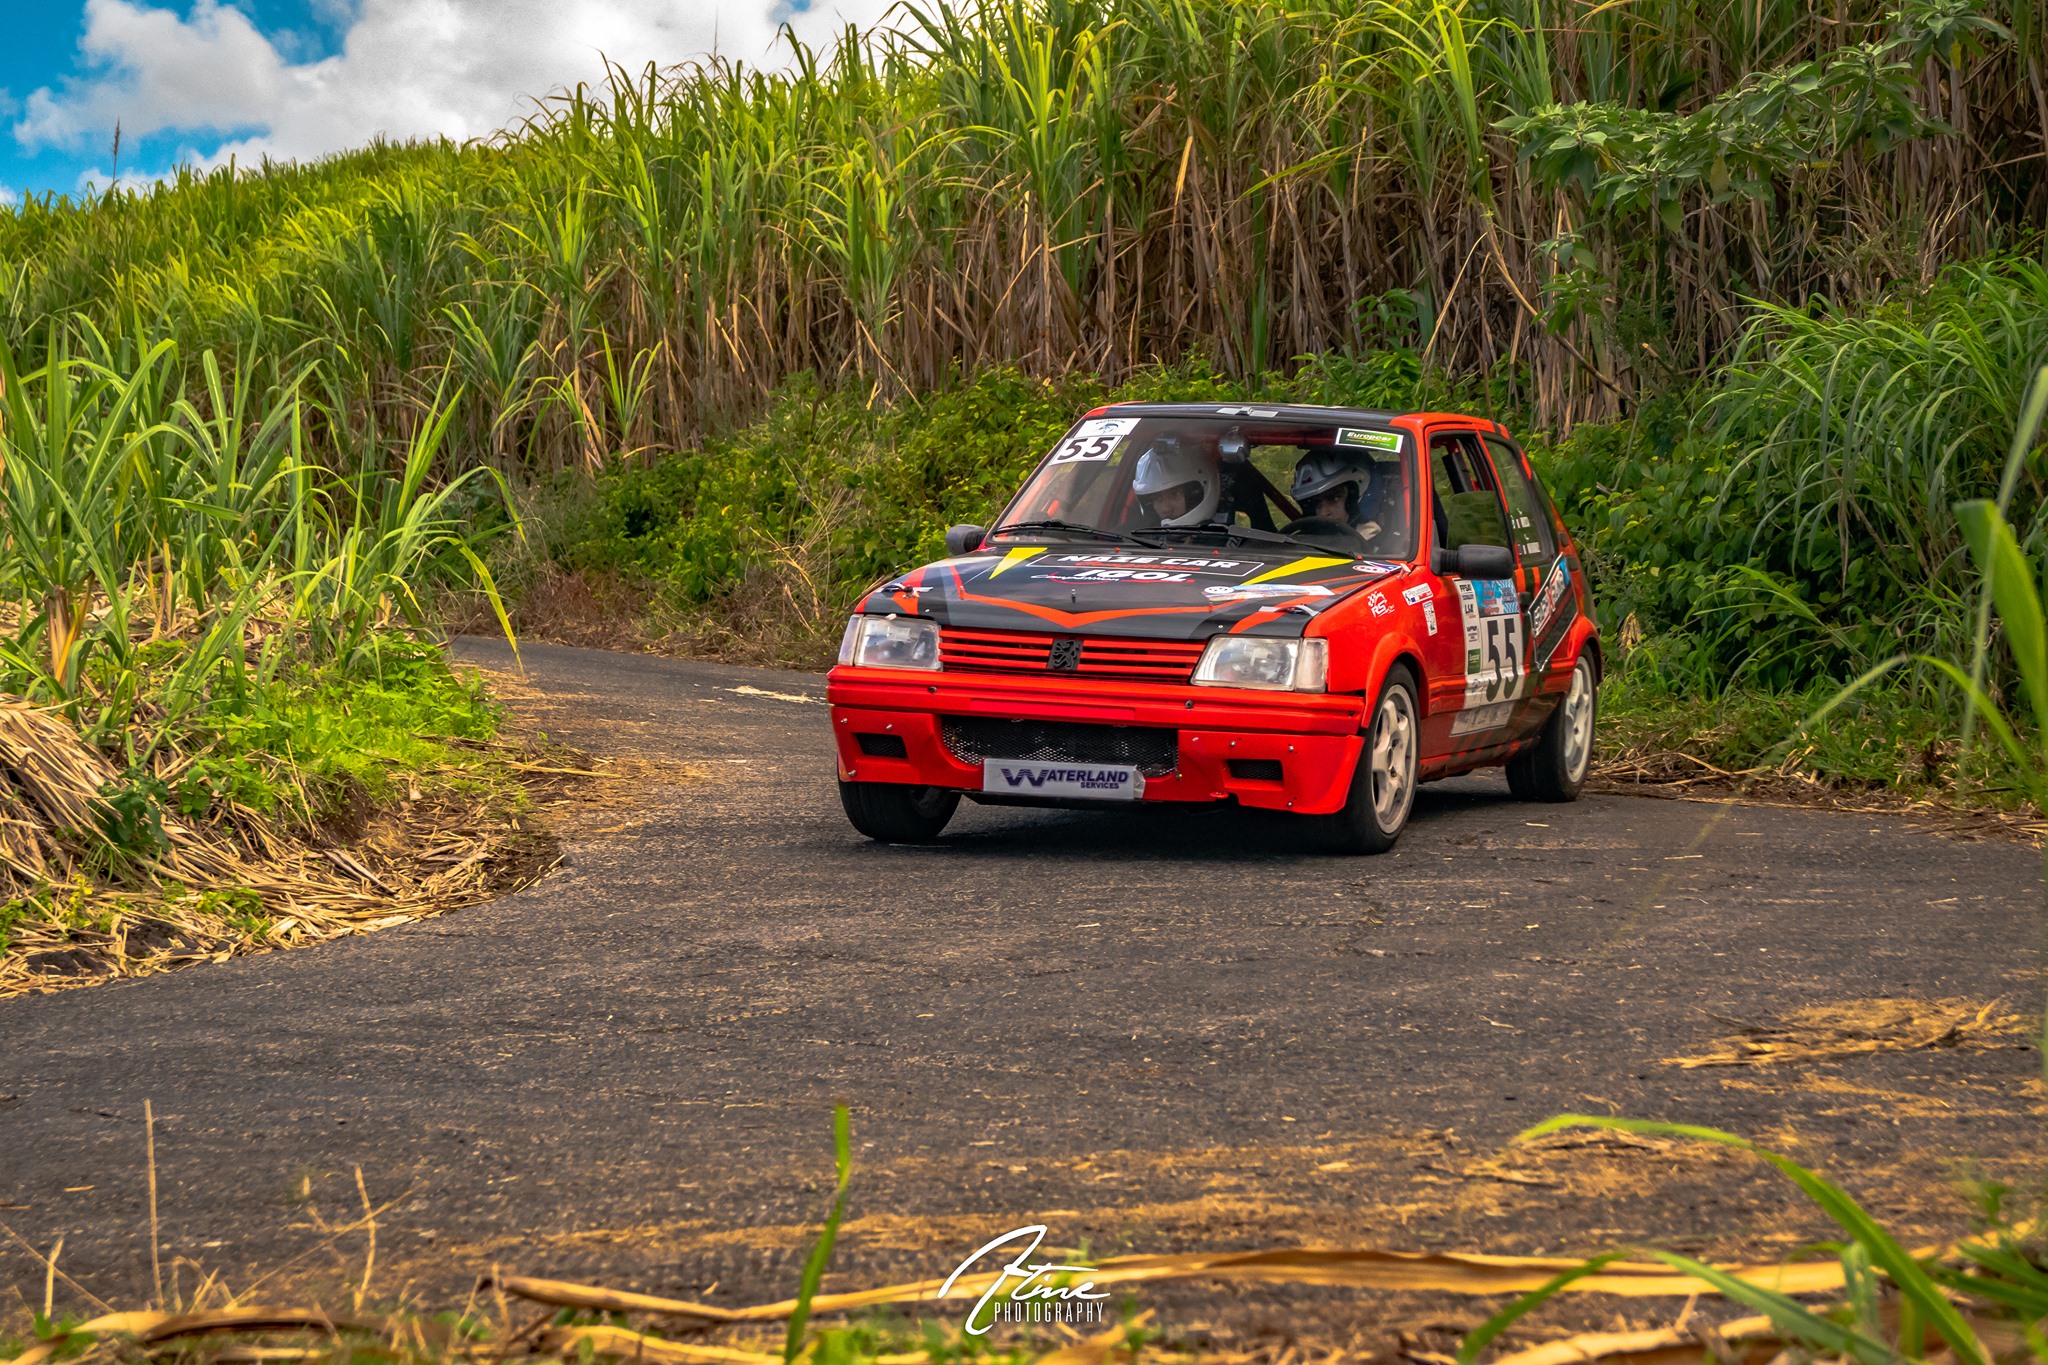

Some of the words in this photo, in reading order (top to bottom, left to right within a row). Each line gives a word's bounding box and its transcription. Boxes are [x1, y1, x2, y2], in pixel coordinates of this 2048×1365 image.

[1346, 431, 1392, 443] Europcar
[1057, 436, 1115, 461] 55
[1057, 555, 1161, 564] NAZE
[1165, 558, 1241, 569] CAR
[1073, 569, 1193, 582] IGOL
[1370, 599, 1387, 618] RS
[1485, 617, 1519, 702] 55
[1001, 768, 1129, 787] WATERLAND
[1080, 781, 1120, 790] SERVICES
